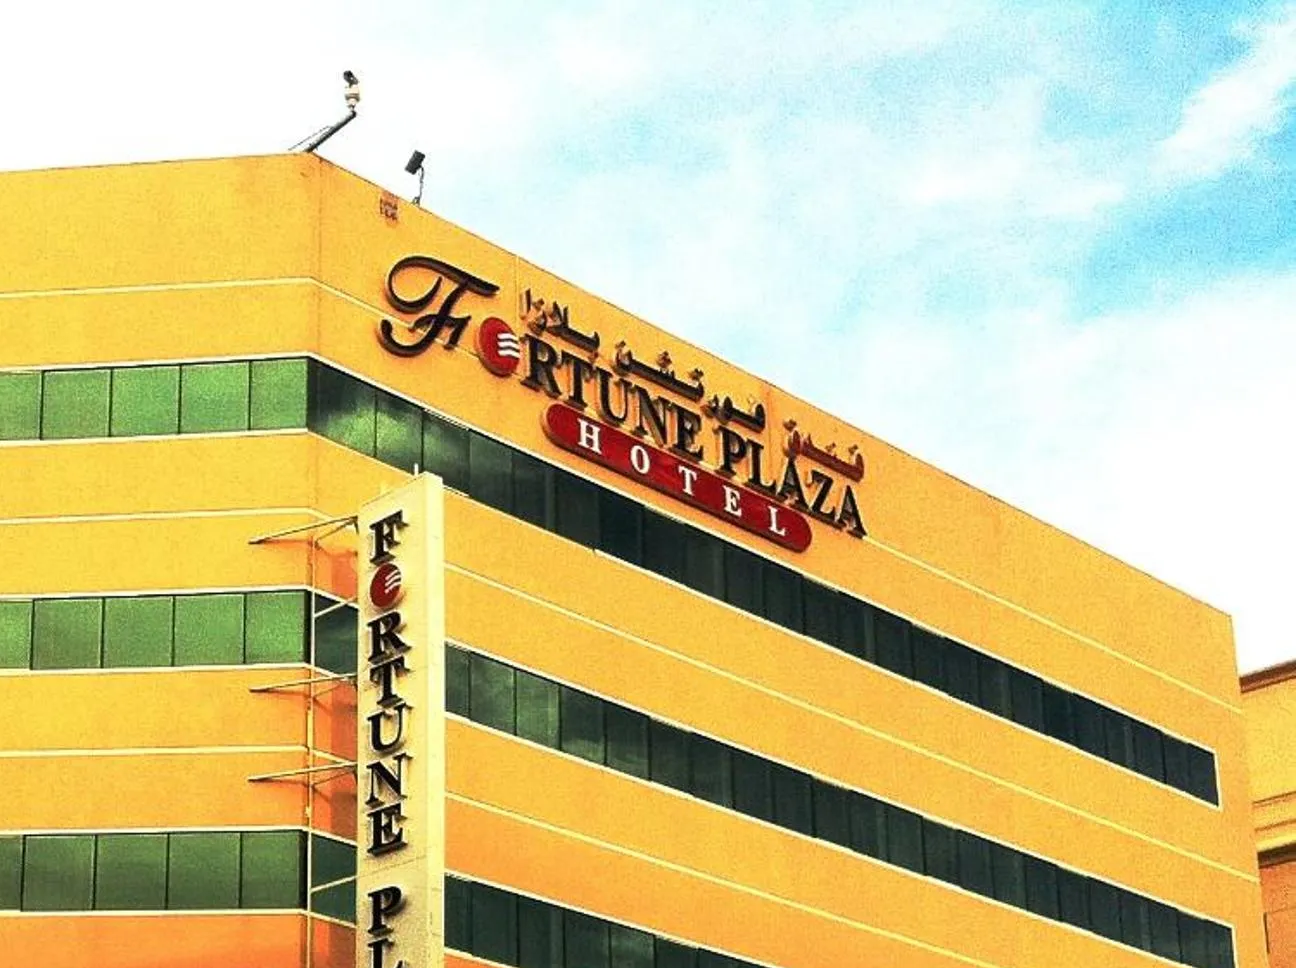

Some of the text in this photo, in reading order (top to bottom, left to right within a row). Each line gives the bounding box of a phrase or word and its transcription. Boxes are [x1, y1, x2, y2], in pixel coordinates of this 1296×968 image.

[377, 254, 867, 540] FORTUNE PLAZA
[576, 417, 788, 538] HOTEL
[366, 509, 412, 857] FORTUNE
